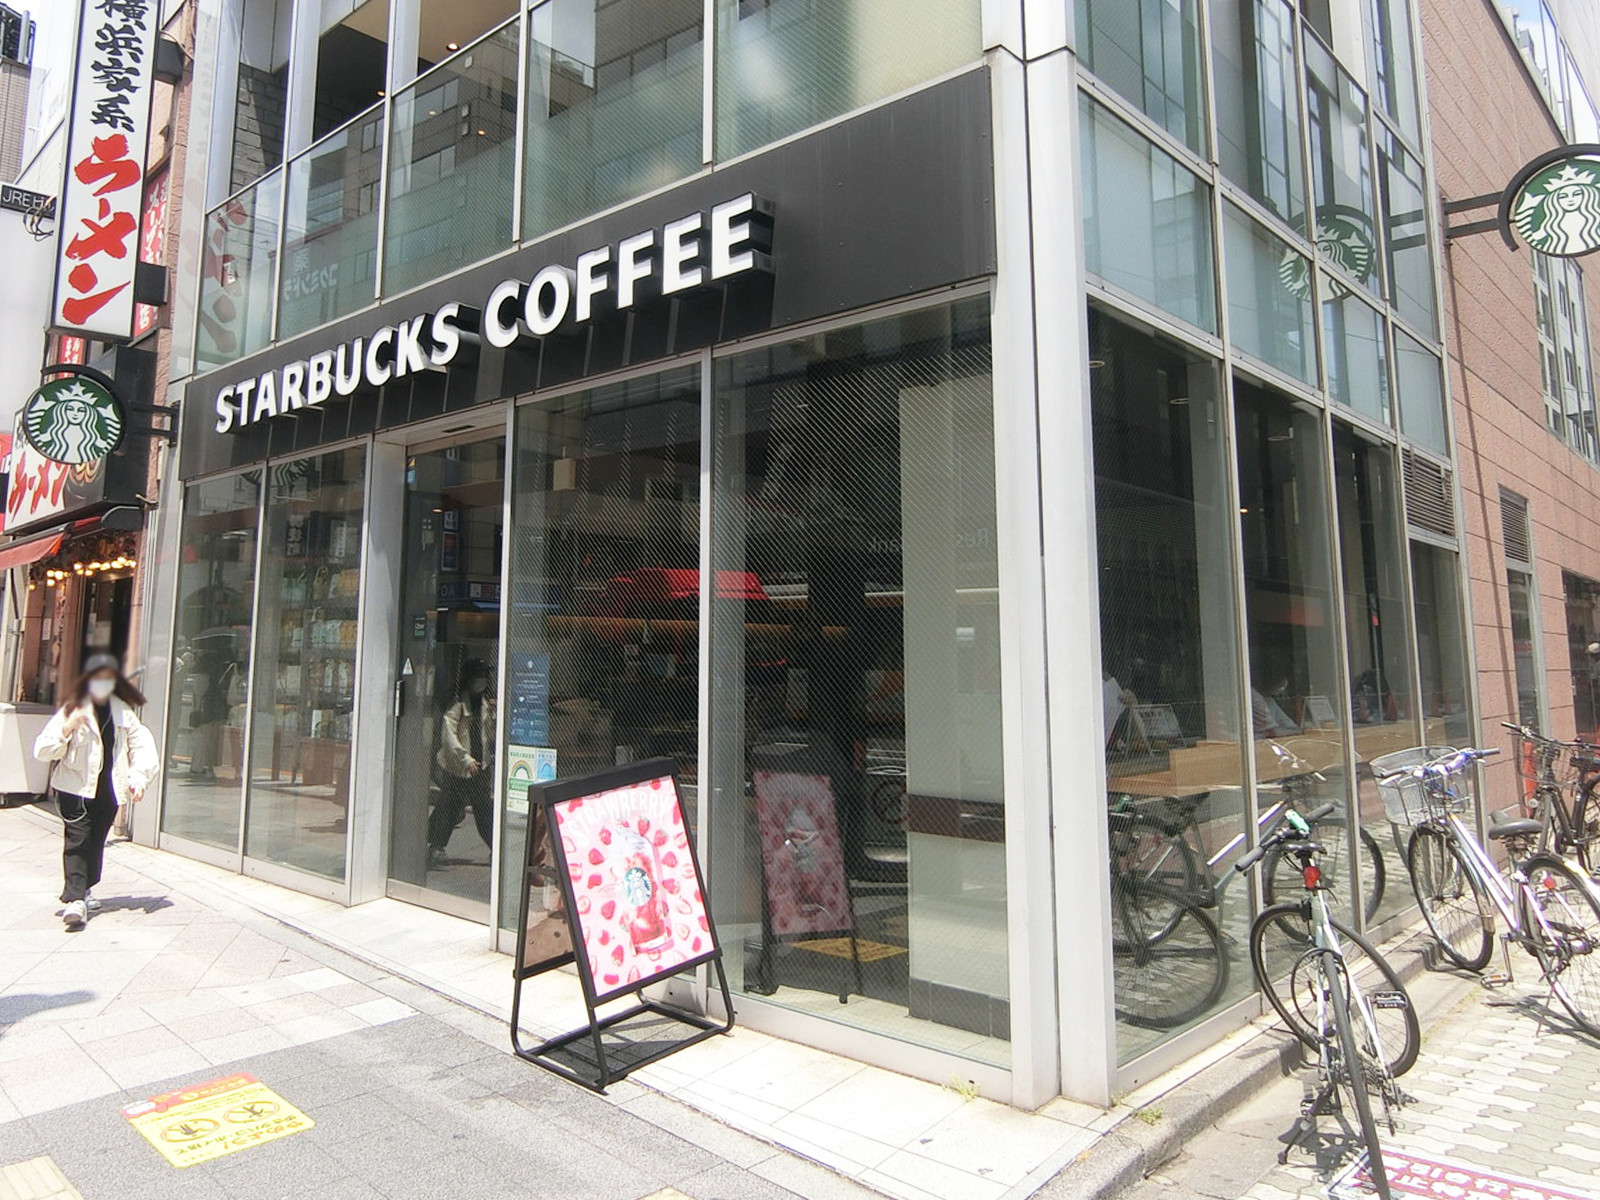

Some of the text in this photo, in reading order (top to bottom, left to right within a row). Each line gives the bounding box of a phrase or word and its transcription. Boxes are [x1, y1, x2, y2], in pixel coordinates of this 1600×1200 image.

[62, 134, 141, 326] ラーメン
[215, 193, 756, 434] STARBUCKS COFFEE
[566, 788, 671, 848] STRAWBERRY
